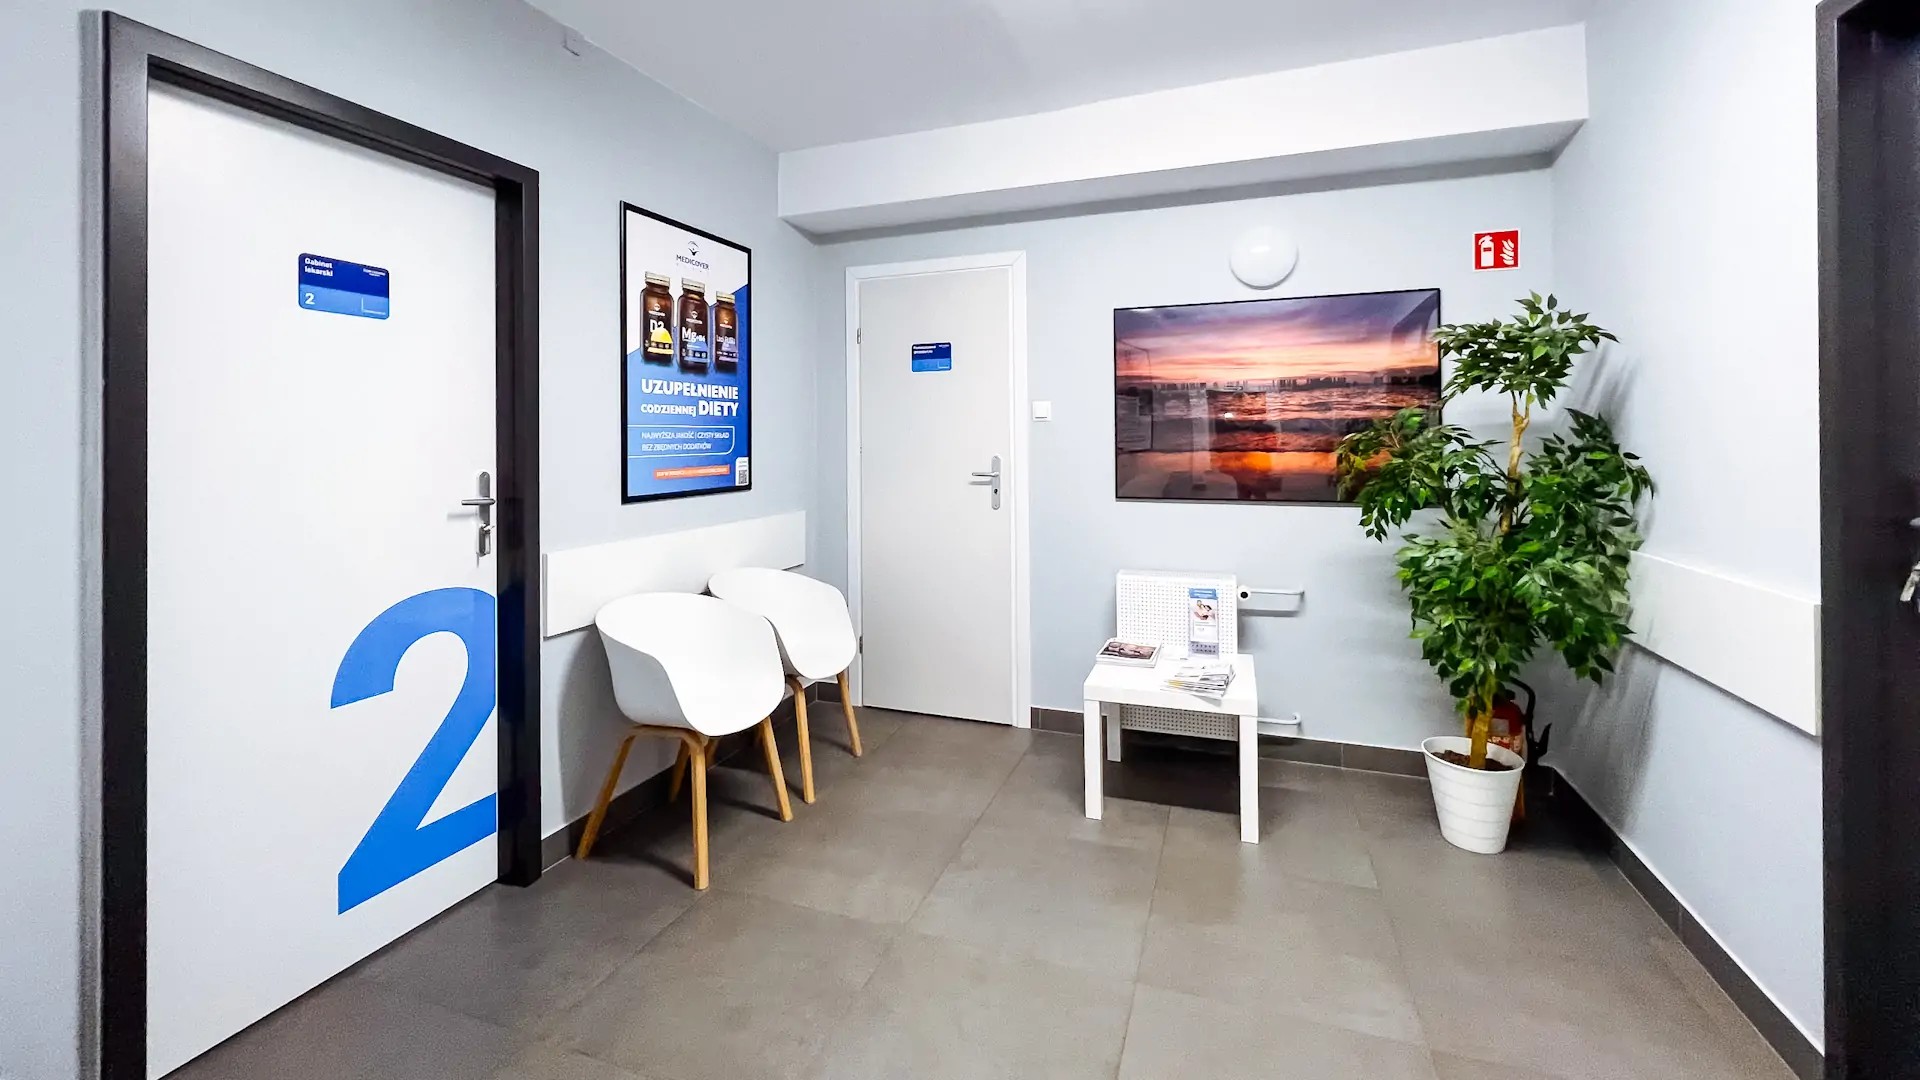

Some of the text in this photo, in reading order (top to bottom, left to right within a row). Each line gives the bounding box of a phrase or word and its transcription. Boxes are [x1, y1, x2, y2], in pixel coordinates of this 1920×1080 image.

[304, 257, 332, 269] Gabinet
[676, 254, 710, 270] MEDICOVER
[304, 266, 333, 277] lekarski
[304, 292, 315, 305] 2
[641, 378, 739, 400] UZUPEŁNIENIE
[641, 400, 739, 417] CODZIENNEJ DIETY
[330, 587, 496, 915] 2
